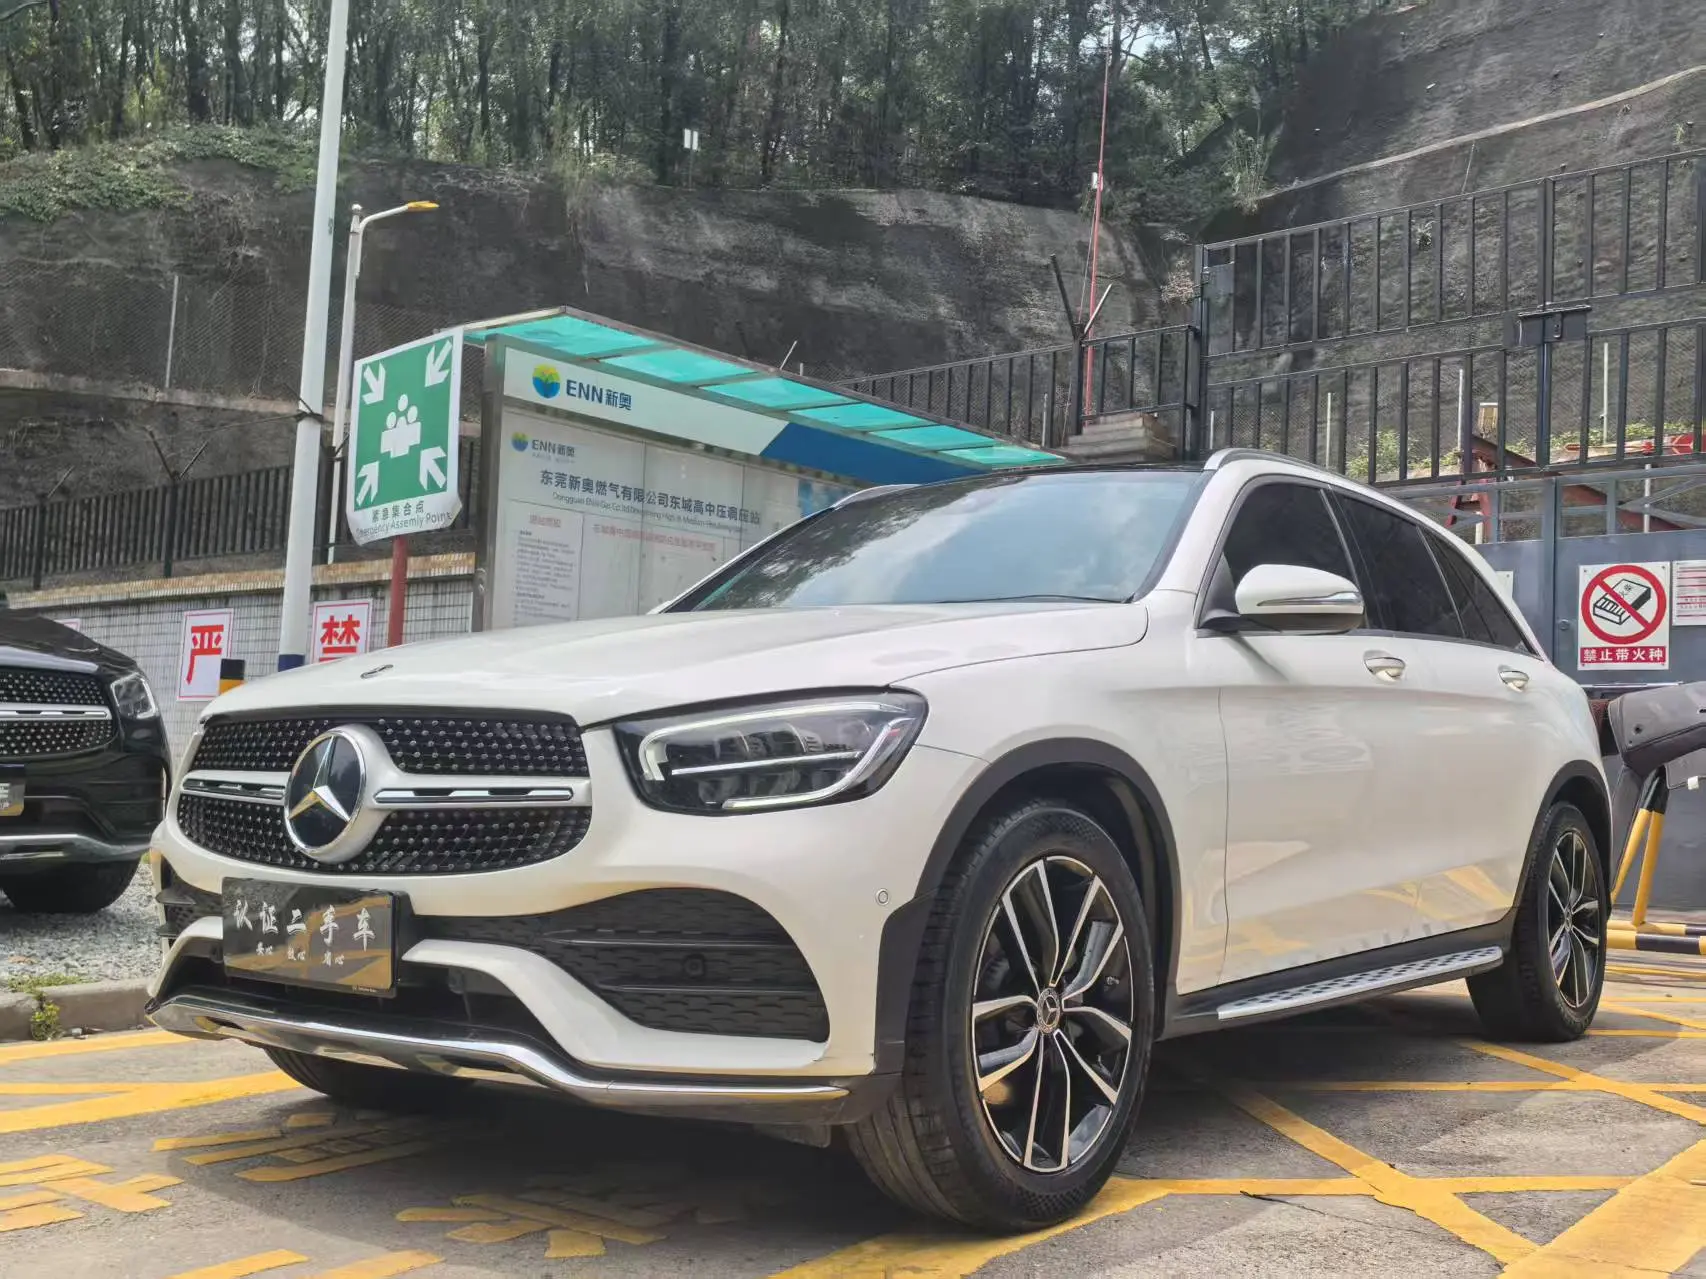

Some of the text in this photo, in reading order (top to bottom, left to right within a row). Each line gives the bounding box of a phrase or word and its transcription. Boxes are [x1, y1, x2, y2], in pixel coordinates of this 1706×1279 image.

[186, 624, 224, 685] 严
[1583, 648, 1664, 662] 禁止带火种
[233, 898, 376, 952] 认证二手车
